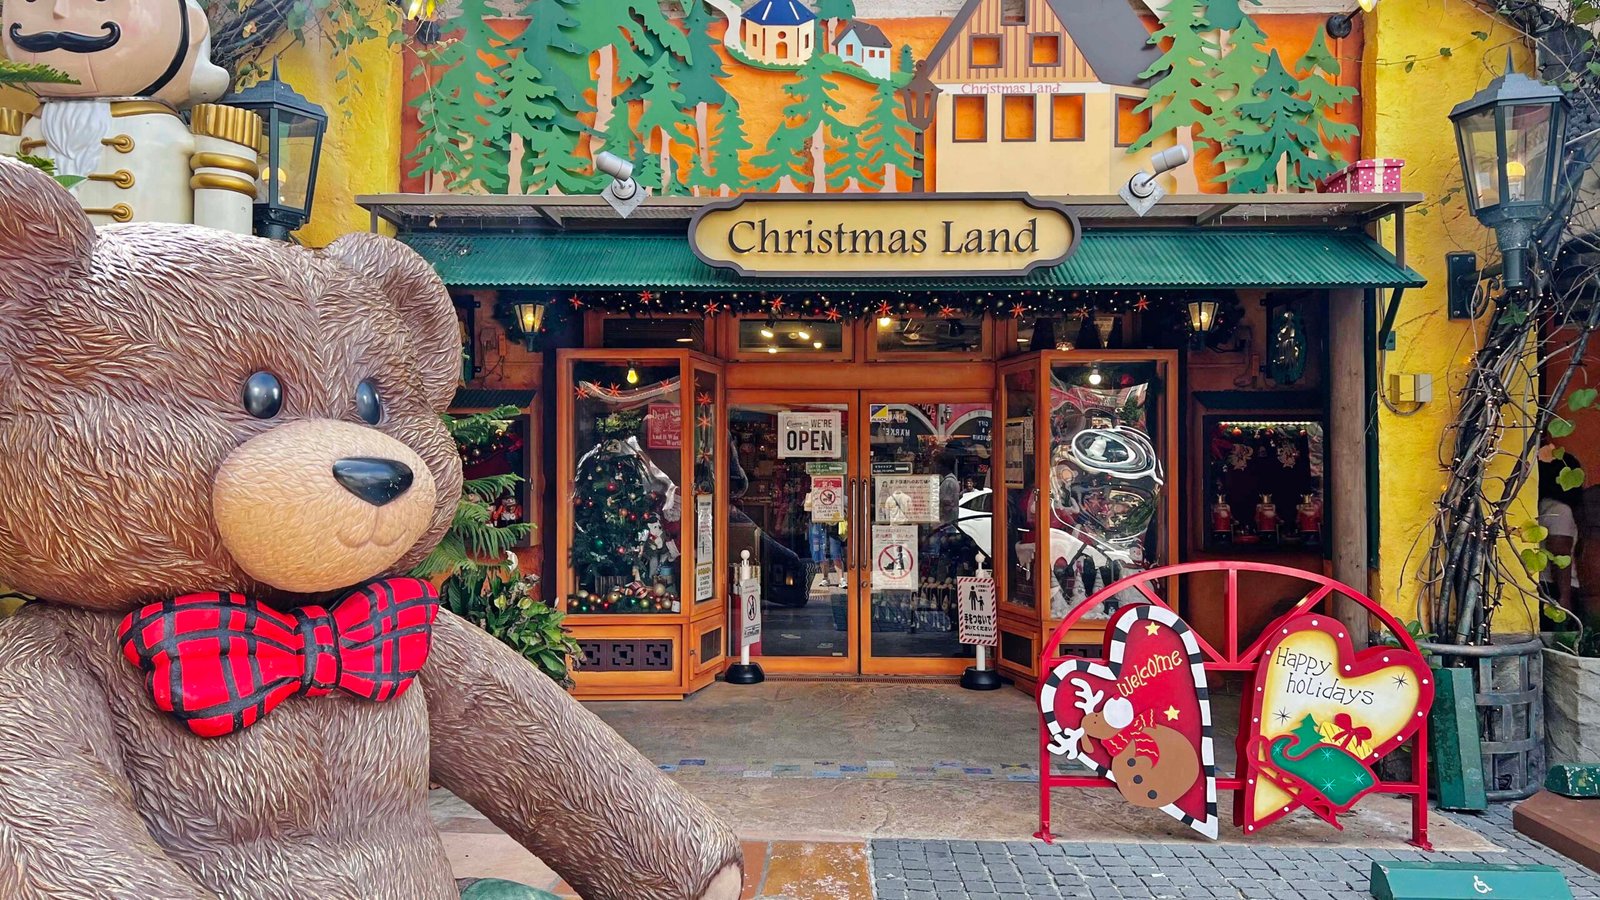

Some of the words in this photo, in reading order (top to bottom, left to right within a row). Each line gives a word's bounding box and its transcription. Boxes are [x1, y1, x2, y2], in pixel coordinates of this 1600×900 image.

[961, 83, 1025, 95] Christmas
[1029, 82, 1061, 94] Land
[728, 218, 927, 254] Christmas
[941, 217, 1039, 254] Land
[811, 419, 832, 428] WE'RE
[787, 430, 833, 451] OPEN
[964, 613, 992, 625] 手をつないで
[1276, 647, 1332, 676] Happy
[1116, 650, 1183, 697] welcome
